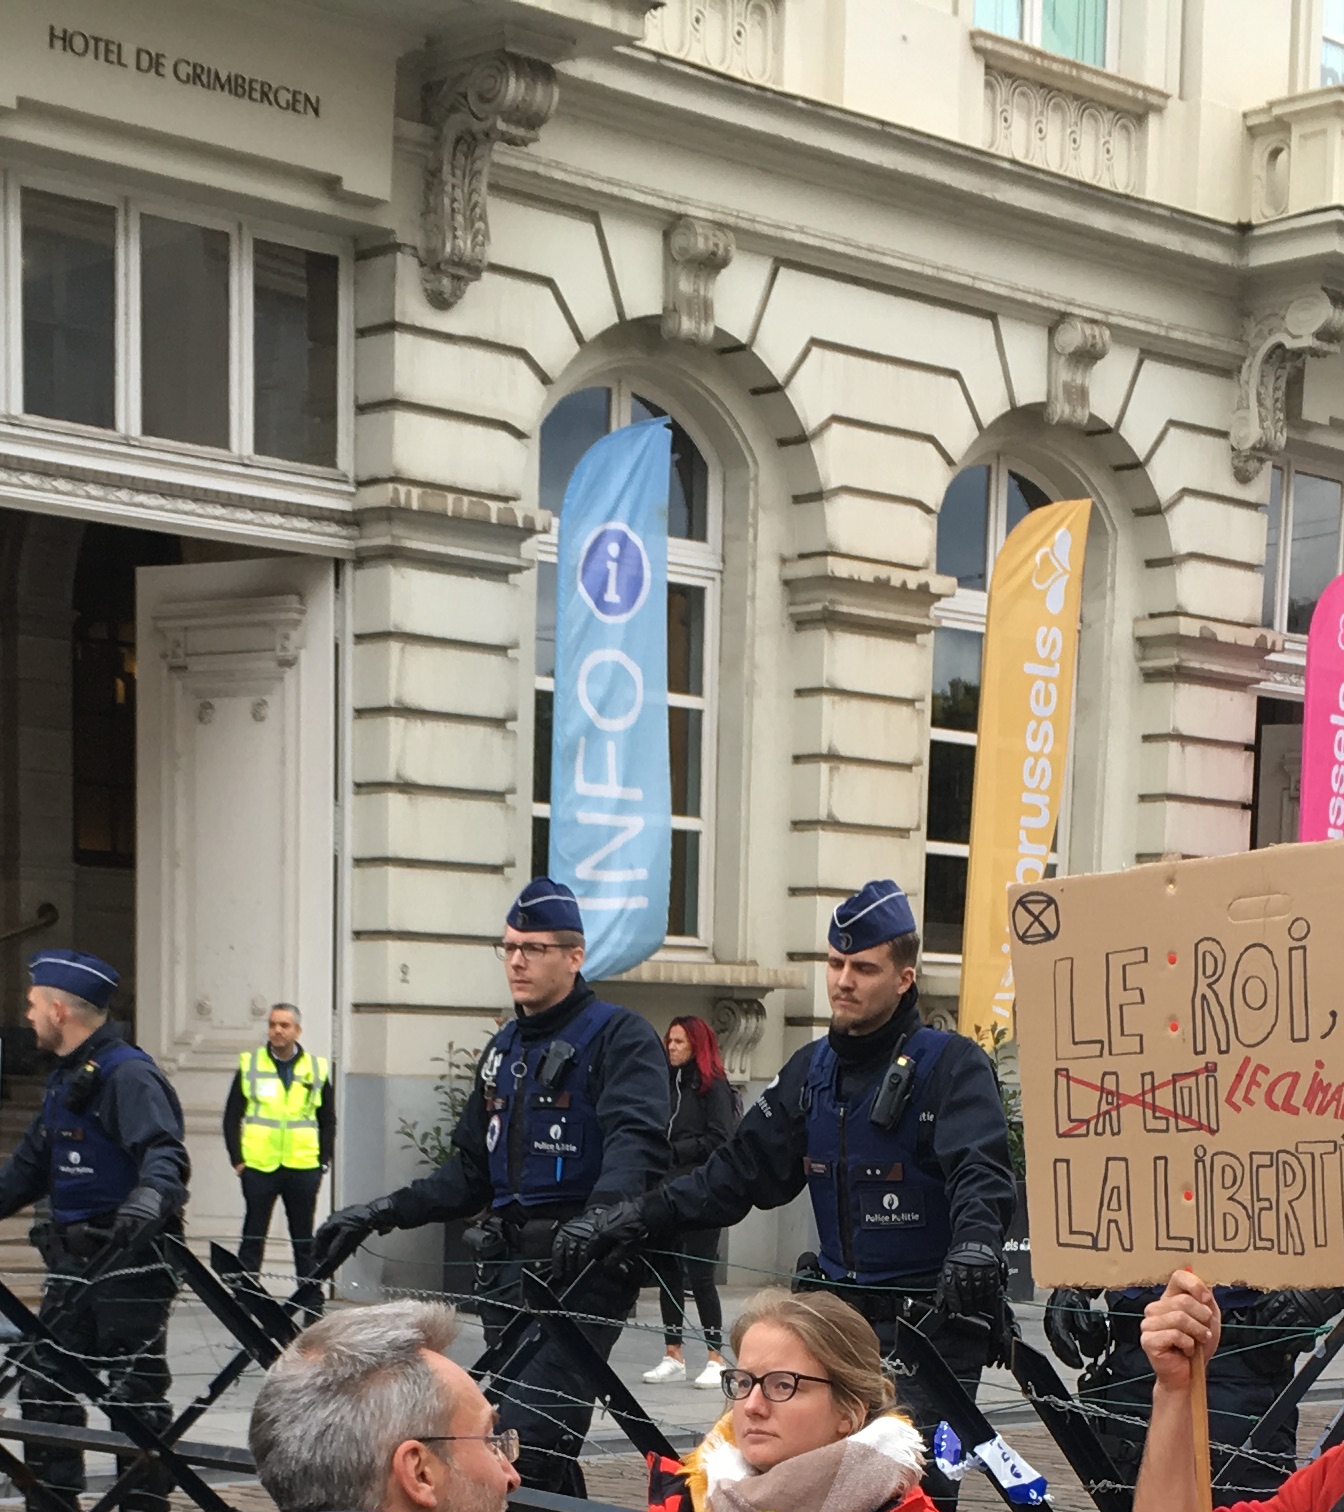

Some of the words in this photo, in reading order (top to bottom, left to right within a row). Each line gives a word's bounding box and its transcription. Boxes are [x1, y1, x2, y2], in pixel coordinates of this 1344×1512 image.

[48, 24, 128, 68] HOTEL
[135, 47, 166, 78] DE
[172, 57, 320, 118] GRIMBERGEN
[574, 648, 649, 911] INFO
[1054, 946, 1148, 1061] LE
[1055, 1068, 1121, 1137] LA
[1054, 1156, 1133, 1252] LA
